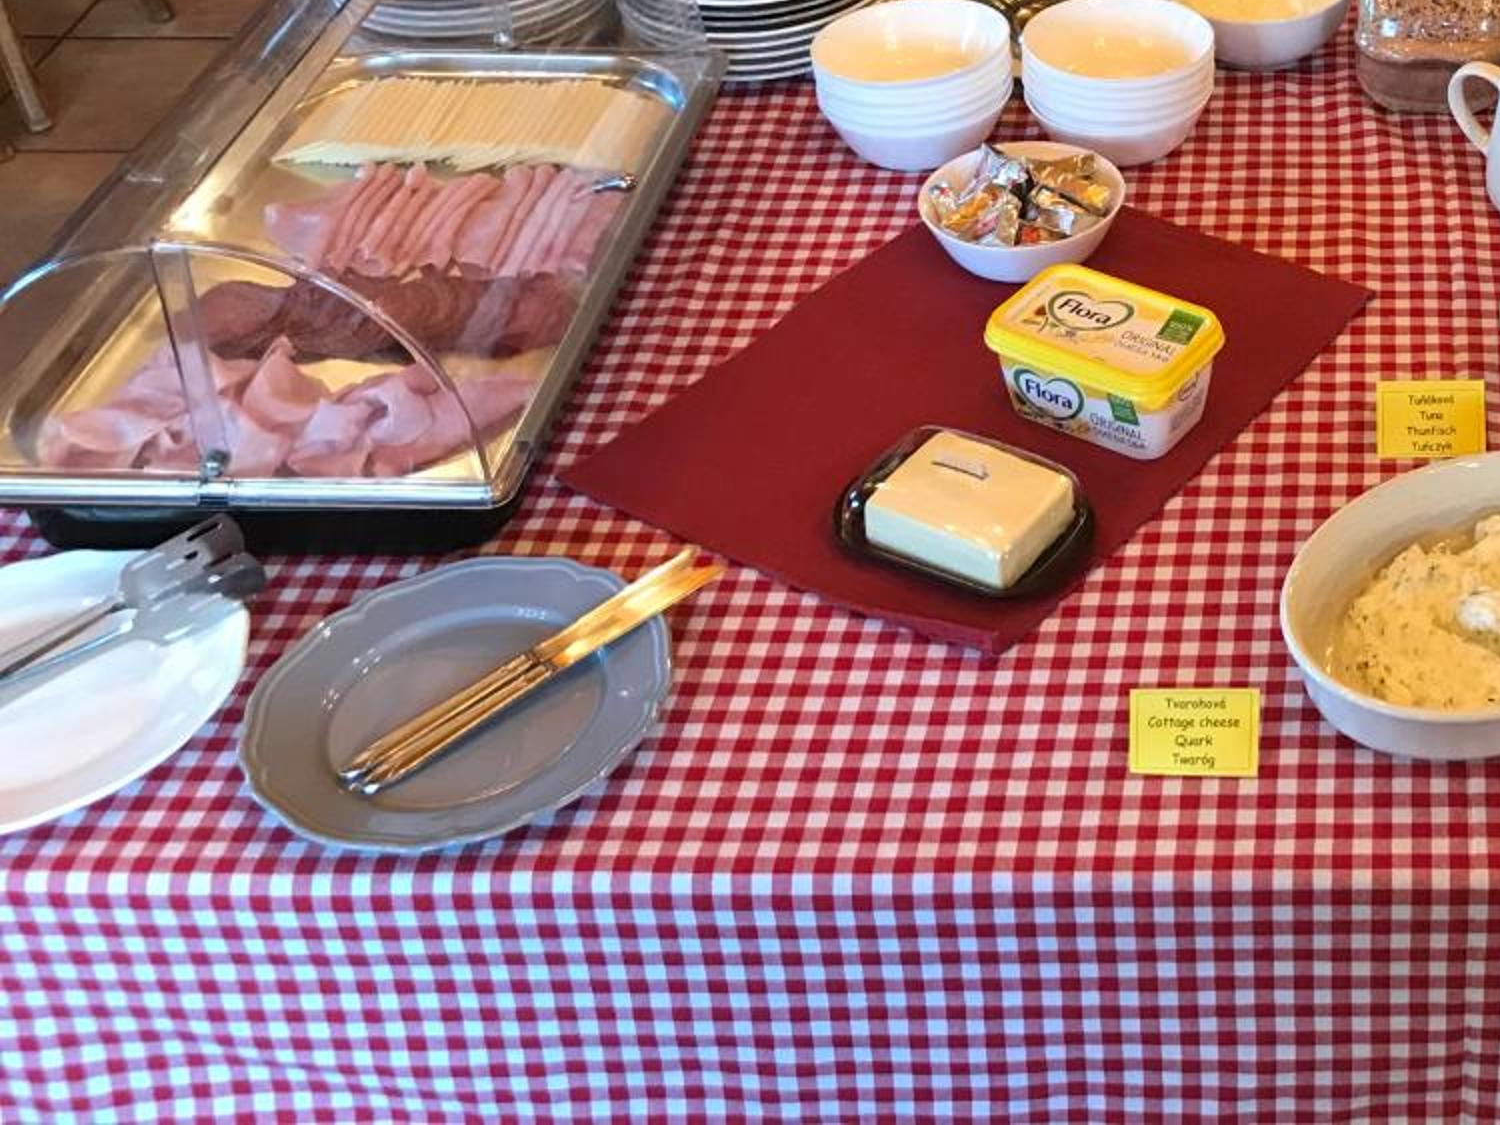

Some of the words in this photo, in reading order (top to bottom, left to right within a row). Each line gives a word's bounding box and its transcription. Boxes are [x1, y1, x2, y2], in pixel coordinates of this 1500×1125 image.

[1057, 298, 1113, 326] Flora
[1025, 378, 1073, 411] Flora
[1147, 716, 1195, 731] Cottage
[1199, 716, 1240, 728] cheese
[1174, 735, 1213, 748] Quark
[1172, 753, 1216, 769] Twaróg
